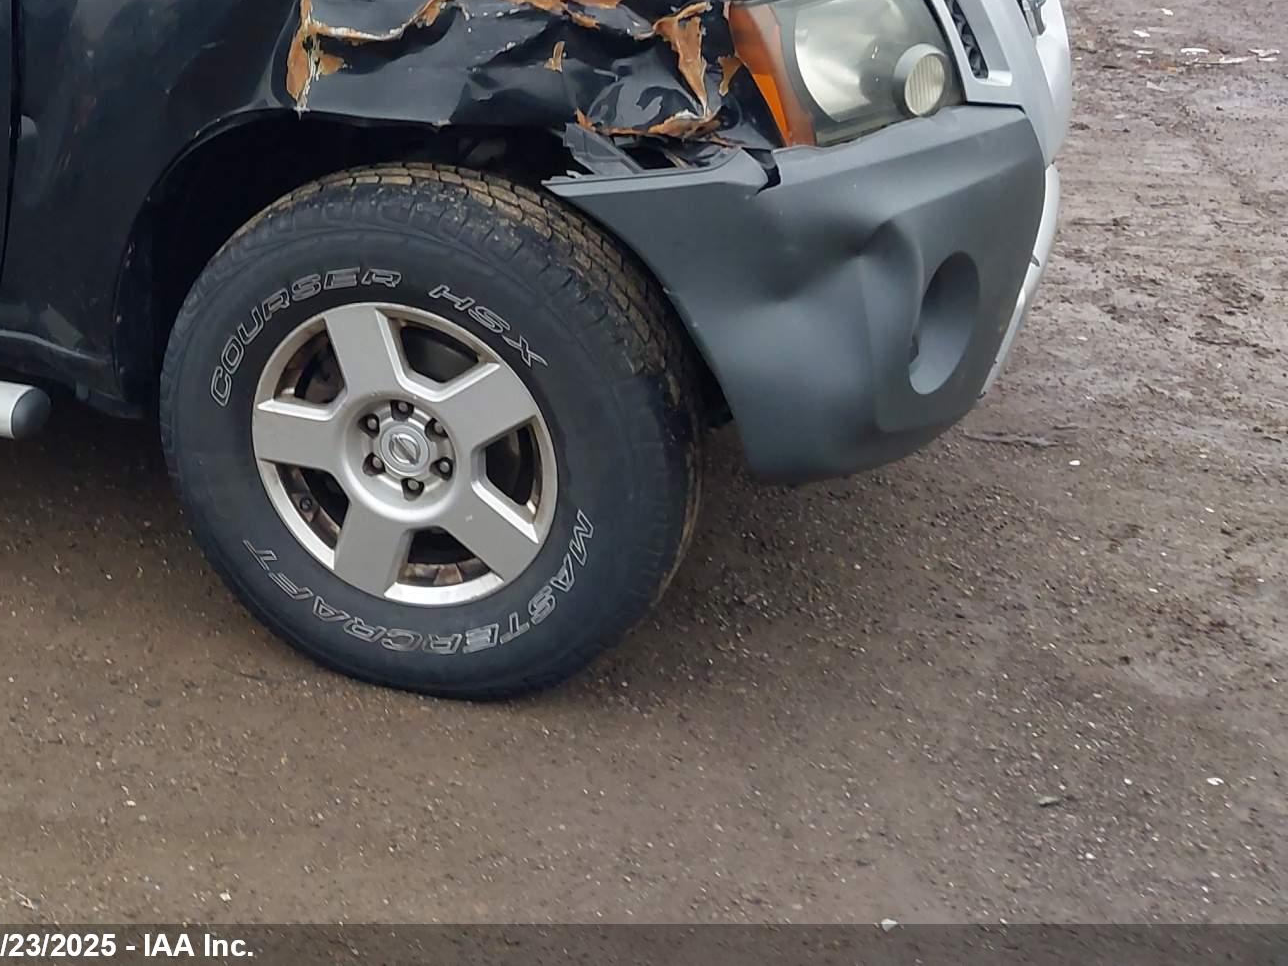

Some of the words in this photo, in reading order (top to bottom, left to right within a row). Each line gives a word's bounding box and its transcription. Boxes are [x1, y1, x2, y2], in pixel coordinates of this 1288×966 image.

[210, 266, 403, 407] COURSER
[429, 285, 548, 368] HSX
[243, 510, 596, 656] MASTERCRAFT
